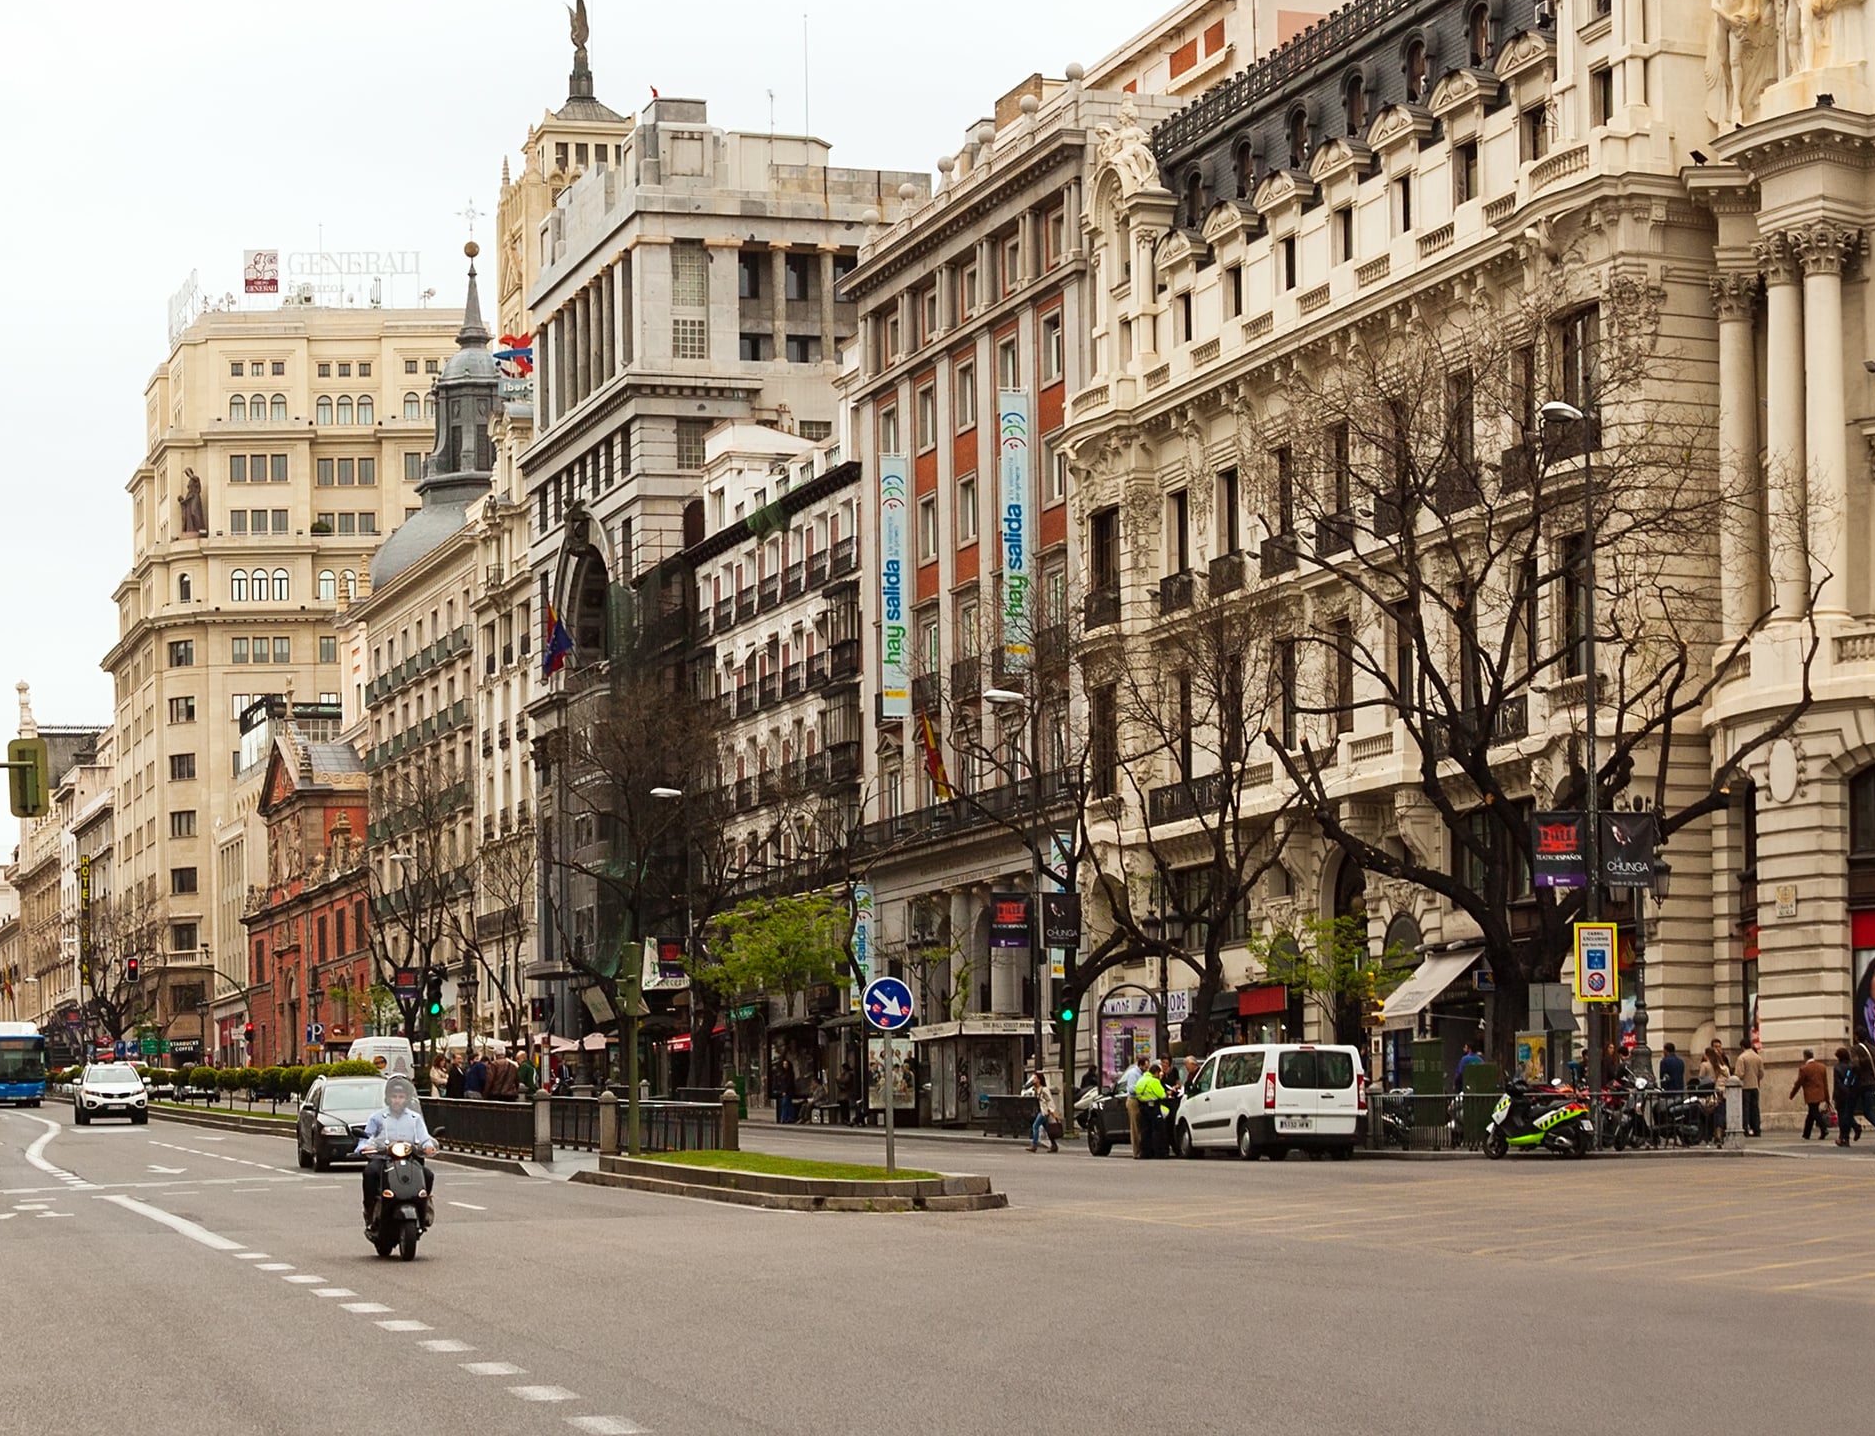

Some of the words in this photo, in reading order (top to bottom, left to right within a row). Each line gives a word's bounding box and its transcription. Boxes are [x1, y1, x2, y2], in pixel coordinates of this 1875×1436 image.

[288, 251, 421, 275] GENERALI
[245, 285, 278, 293] GENERALI
[1003, 504, 1023, 570] salida
[882, 559, 900, 622] salida
[884, 626, 905, 665] hay
[1536, 853, 1582, 861] TEATROESPAÑOL
[1607, 861, 1650, 872] CHUNGA
[82, 855, 90, 910] HOTEL
[857, 925, 867, 961] salida
[1045, 928, 1078, 939] CHUNGA
[169, 1039, 199, 1047] STARBUCKS
[312, 1023, 323, 1042] P
